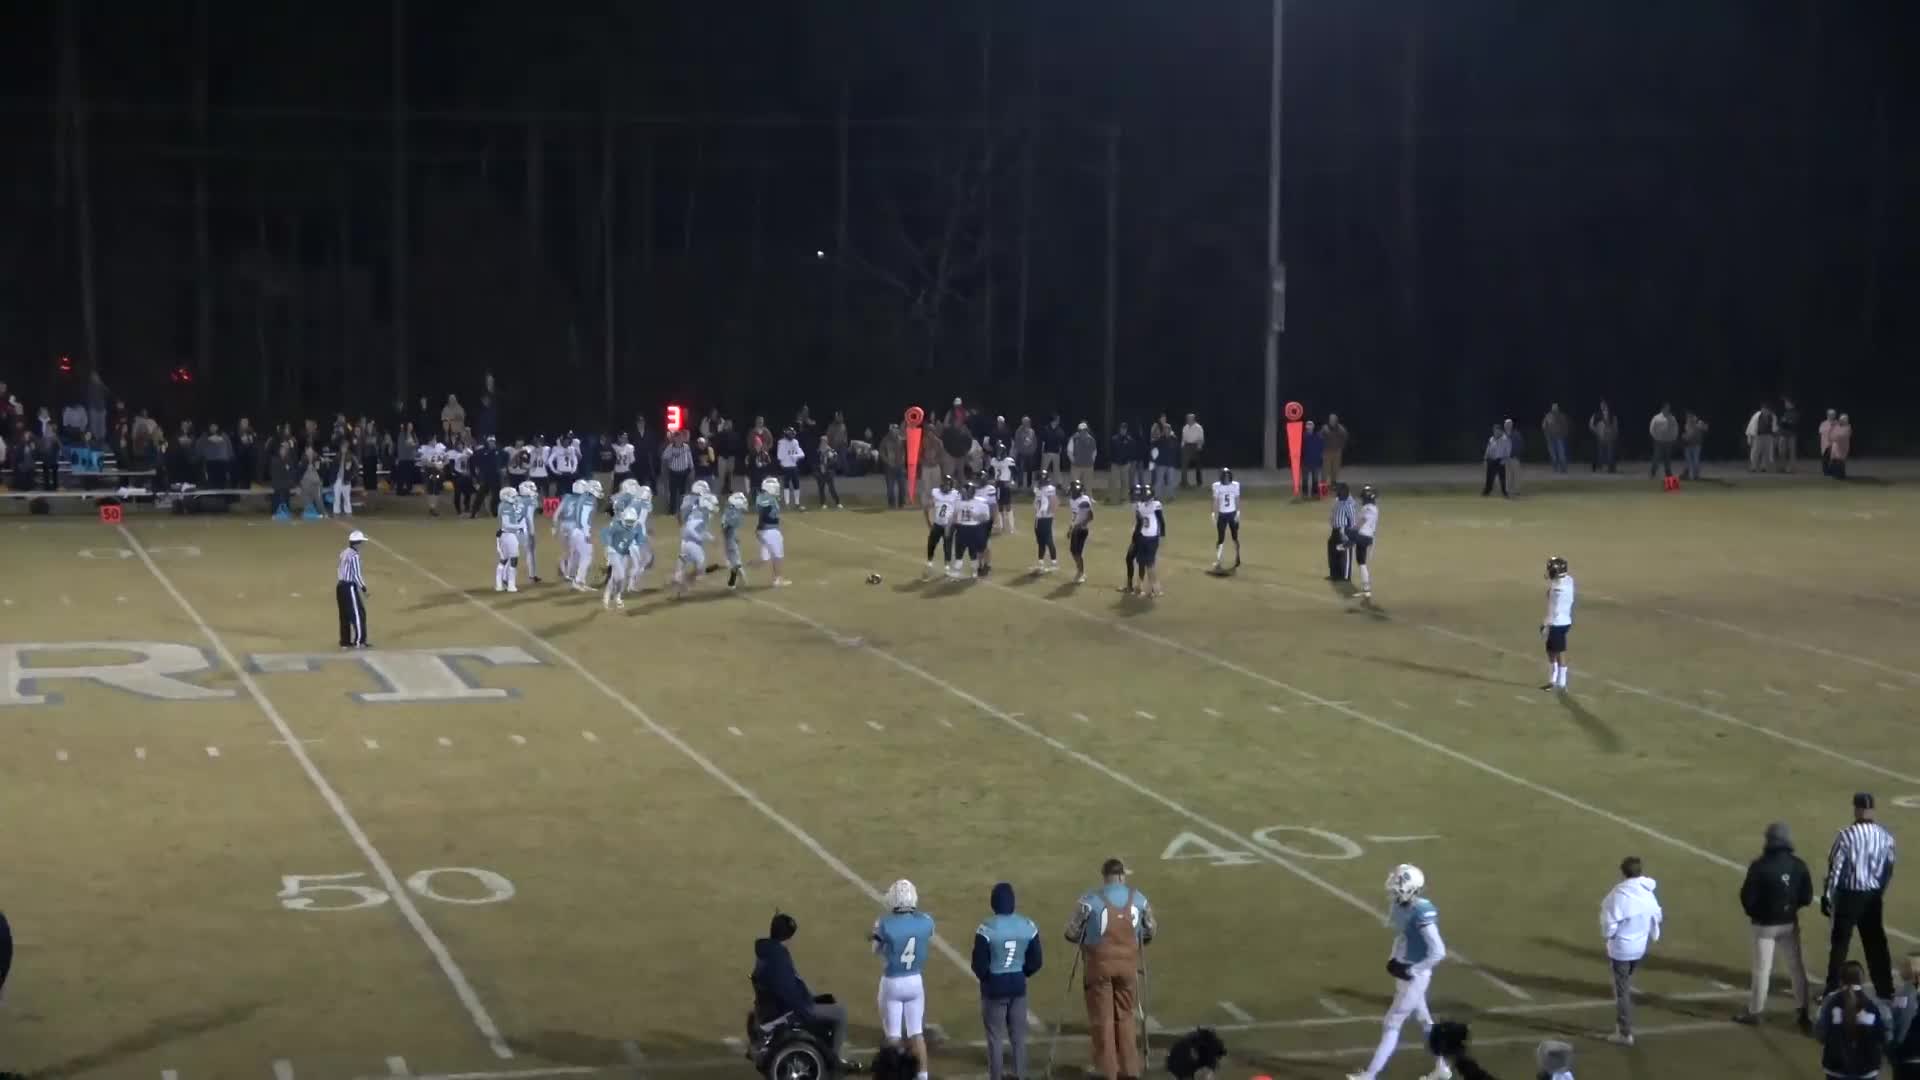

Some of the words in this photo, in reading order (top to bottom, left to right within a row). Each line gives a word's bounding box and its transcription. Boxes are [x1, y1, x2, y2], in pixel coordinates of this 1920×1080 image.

[667, 405, 681, 430] 3
[103, 508, 119, 520] 50
[1223, 495, 1231, 508] 5
[1161, 825, 1363, 866] 40
[278, 866, 515, 911] 50
[900, 936, 916, 970] 4
[1004, 941, 1017, 968] 7
